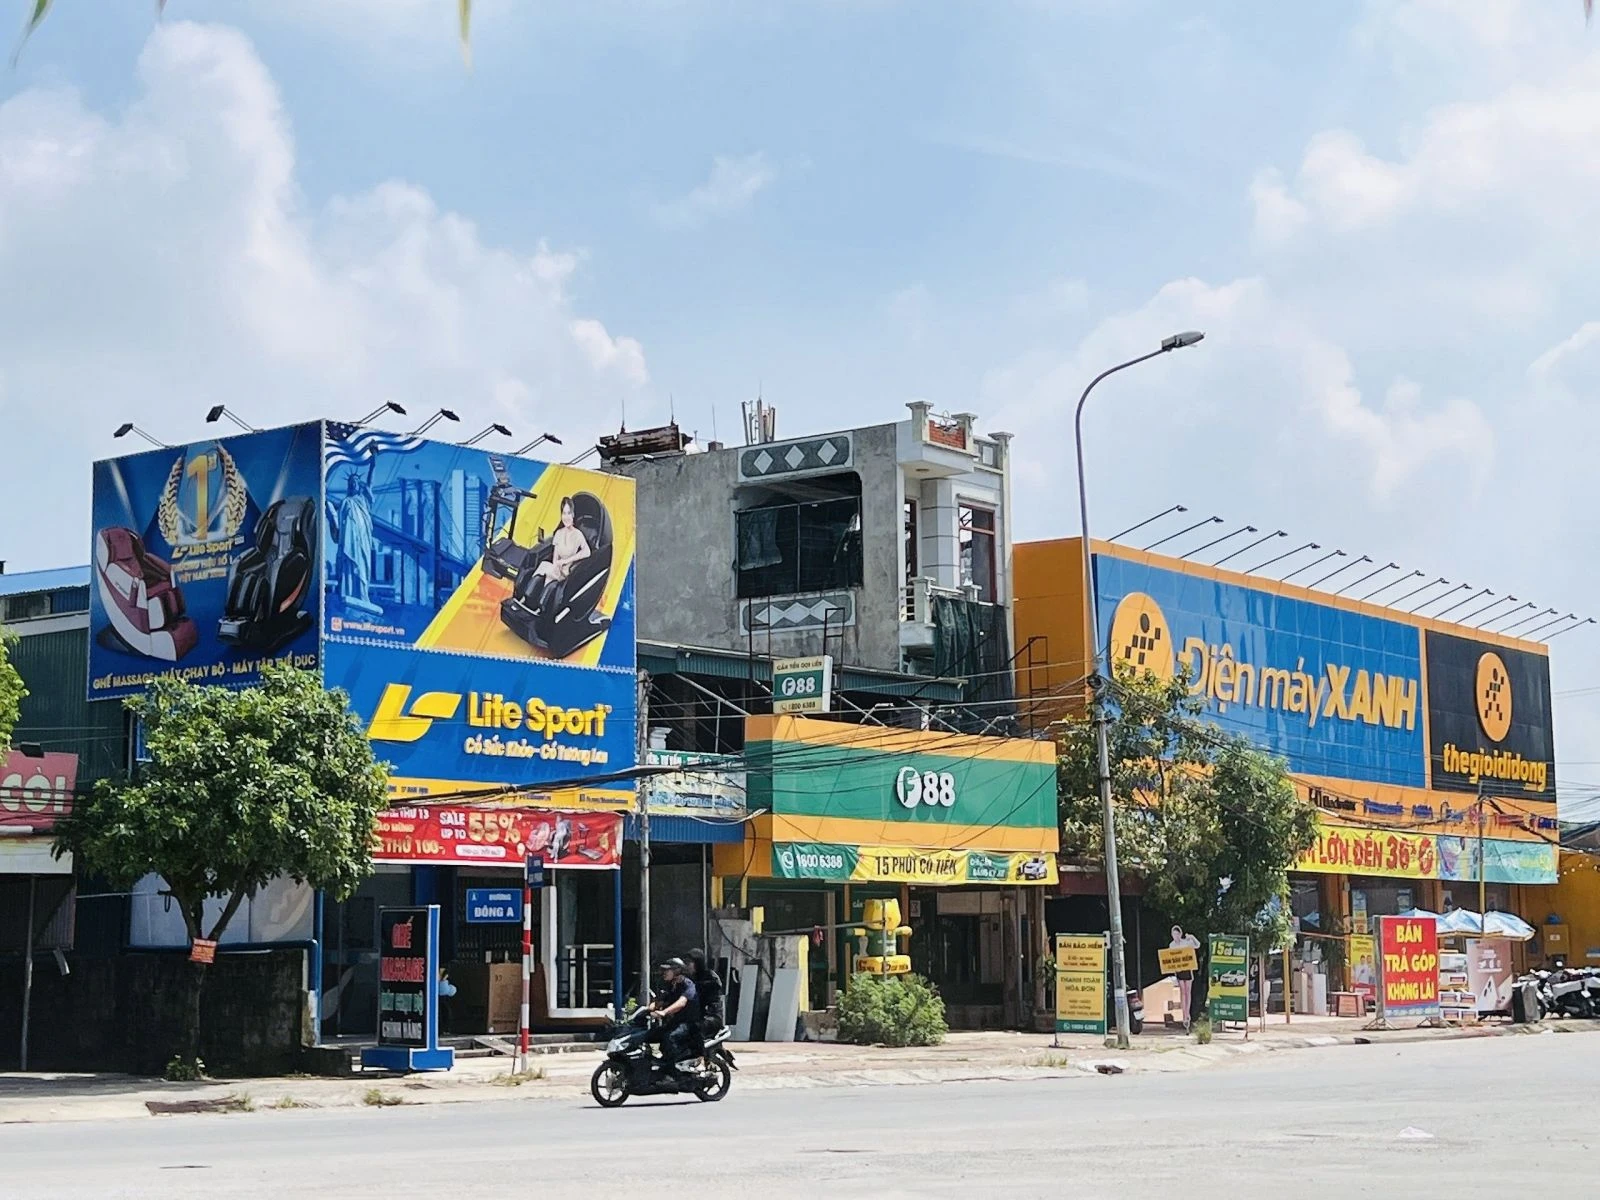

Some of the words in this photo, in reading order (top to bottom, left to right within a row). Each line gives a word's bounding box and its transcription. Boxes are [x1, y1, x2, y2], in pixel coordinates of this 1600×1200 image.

[93, 672, 112, 690] GHẾ
[113, 673, 154, 688] MASSAGE
[212, 661, 225, 677] BỘ
[233, 659, 253, 675] MÁY
[1177, 636, 1255, 713] Điện
[1259, 656, 1326, 728] máy
[1323, 663, 1418, 731] XANH
[781, 677, 815, 696] F88
[469, 691, 523, 730] Life
[526, 697, 607, 740] Sport
[1443, 742, 1547, 793] thegioididong
[897, 766, 955, 808] F88
[439, 812, 465, 827] SALE
[440, 829, 453, 840] UP
[454, 829, 466, 840] TO
[1320, 831, 1349, 866] LỚN
[1354, 831, 1383, 868] ĐẾN
[796, 853, 819, 869] 1800
[819, 855, 843, 870] 6388
[875, 856, 890, 876] 15
[891, 853, 917, 875] PHÚT
[919, 854, 932, 875] CÓ
[934, 853, 958, 876] TIỀN
[474, 904, 504, 918] ĐÔNG
[506, 907, 514, 917] A
[1395, 920, 1423, 943] BÁN
[1058, 941, 1072, 949] BÁN
[1211, 941, 1225, 956] 15
[1384, 947, 1410, 972] TRẢ
[1411, 948, 1436, 973] GÓP
[1387, 978, 1419, 1001] KHÔNG
